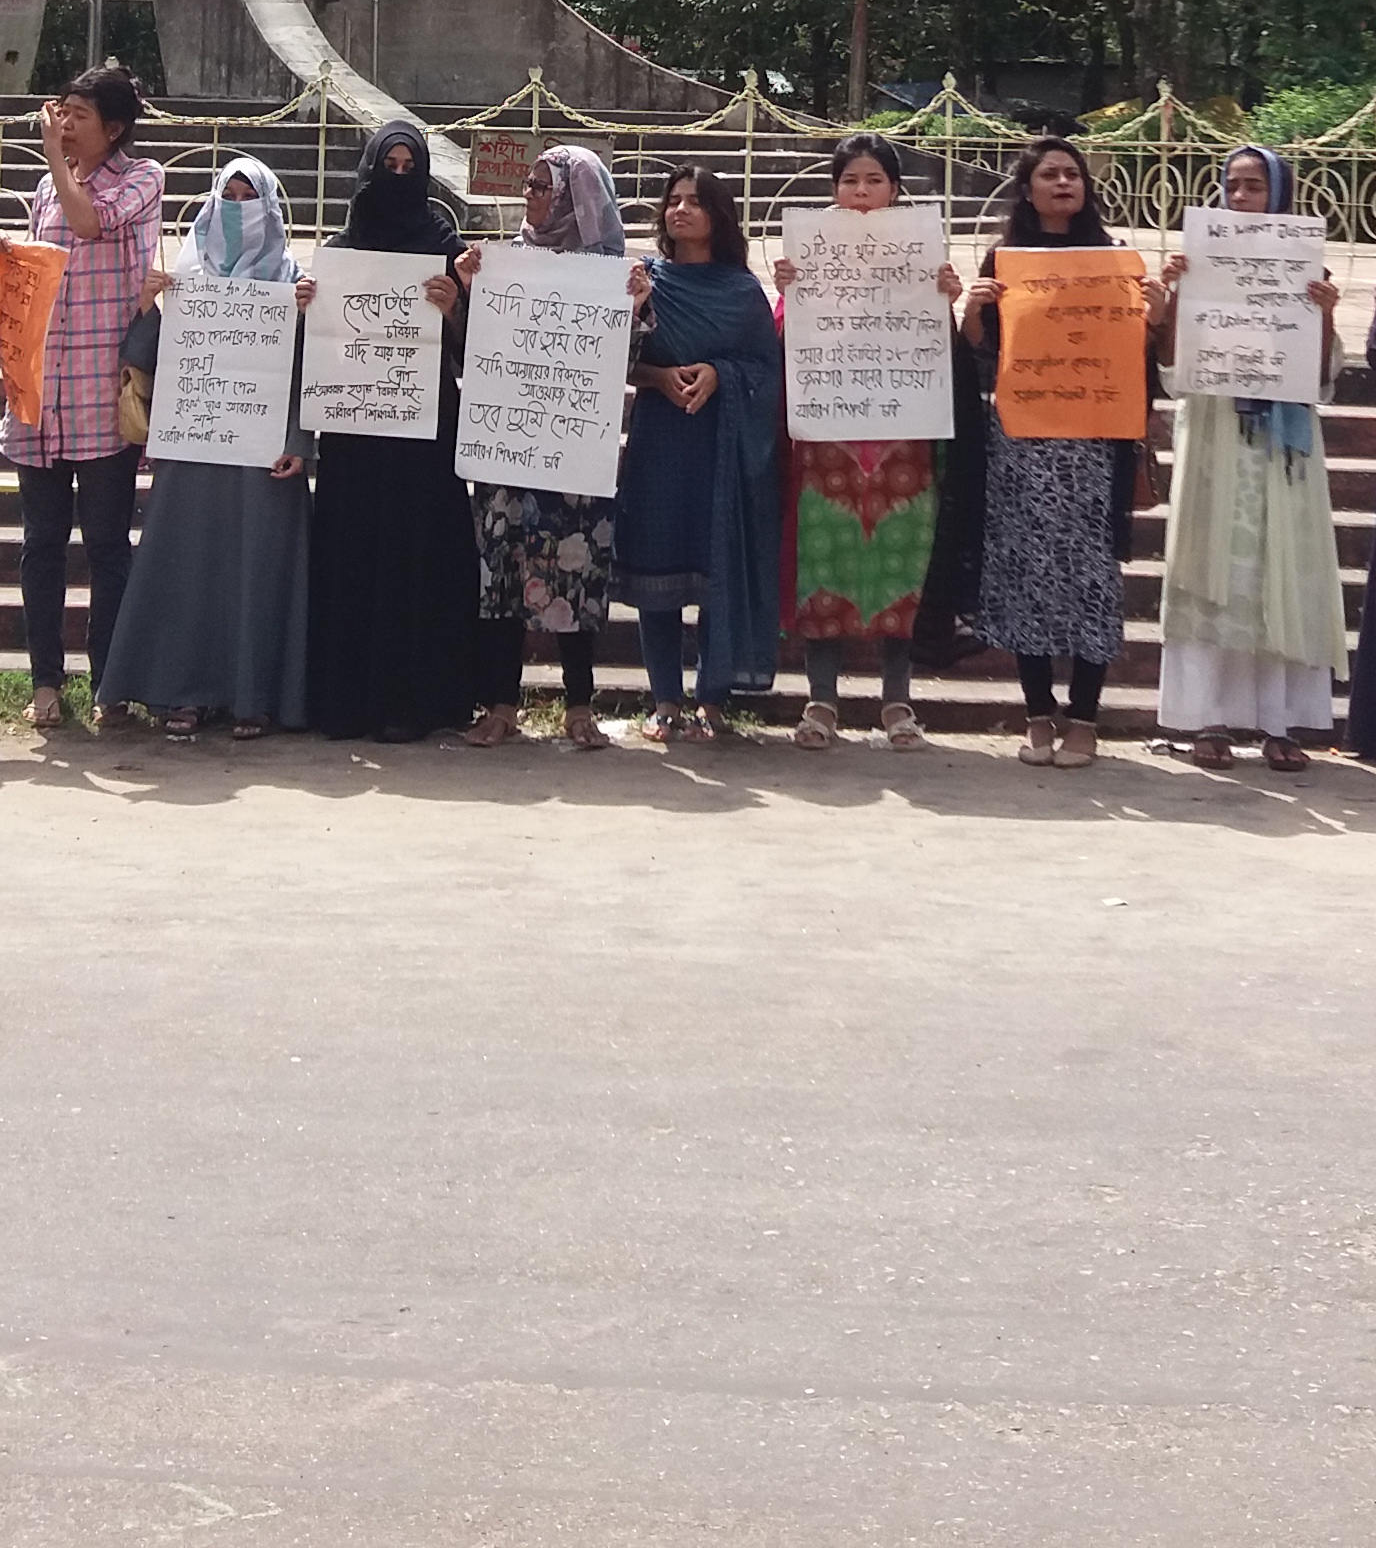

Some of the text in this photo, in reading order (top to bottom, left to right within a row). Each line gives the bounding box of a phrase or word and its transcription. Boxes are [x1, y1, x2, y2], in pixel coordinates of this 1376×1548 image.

[1207, 224, 1229, 238] WE
[179, 299, 289, 324] ভারত সফর শেষে
[530, 291, 569, 325] তুমি
[571, 303, 602, 330] চুপ
[174, 330, 205, 349] ভারত
[344, 338, 419, 364] যদি যায় যাক
[512, 329, 538, 354] তবে
[540, 326, 571, 357] তুমি
[474, 351, 503, 377] যদি
[233, 380, 257, 395] পেল
[518, 383, 565, 406] আওয়াজ
[469, 403, 502, 433] তবে
[506, 400, 549, 438] তুমি
[551, 414, 599, 439] শেষ
[542, 451, 564, 469] চবি
